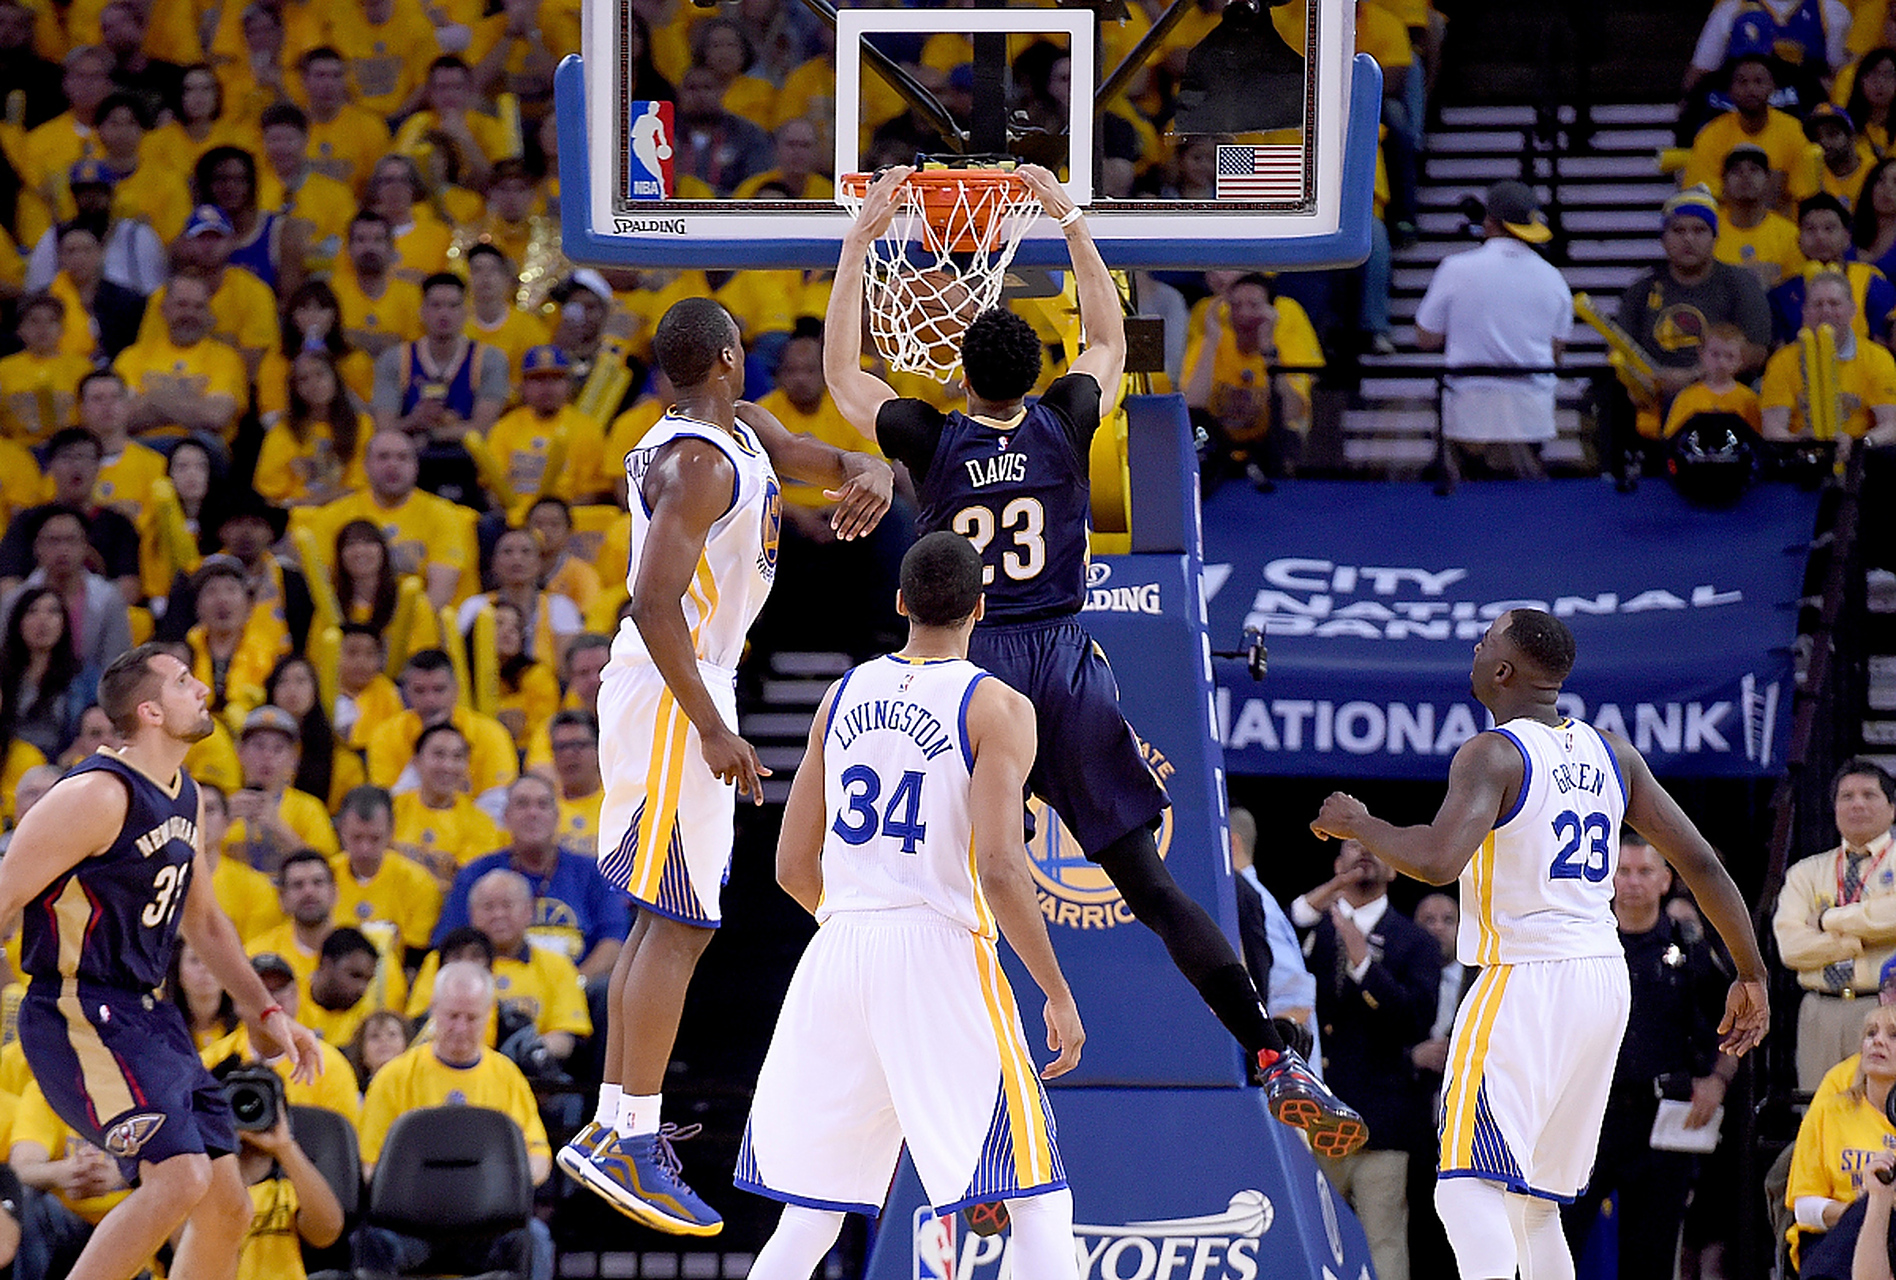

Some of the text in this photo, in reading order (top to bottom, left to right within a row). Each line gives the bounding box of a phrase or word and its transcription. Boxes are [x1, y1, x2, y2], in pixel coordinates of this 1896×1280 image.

[633, 181, 659, 195] NBA
[613, 219, 686, 234] SPALDING
[965, 453, 1027, 488] DAVIS
[1263, 557, 1468, 596] CITY
[834, 700, 953, 761] LIVINGSTON
[831, 764, 926, 854] 34
[1549, 810, 1611, 882] 23
